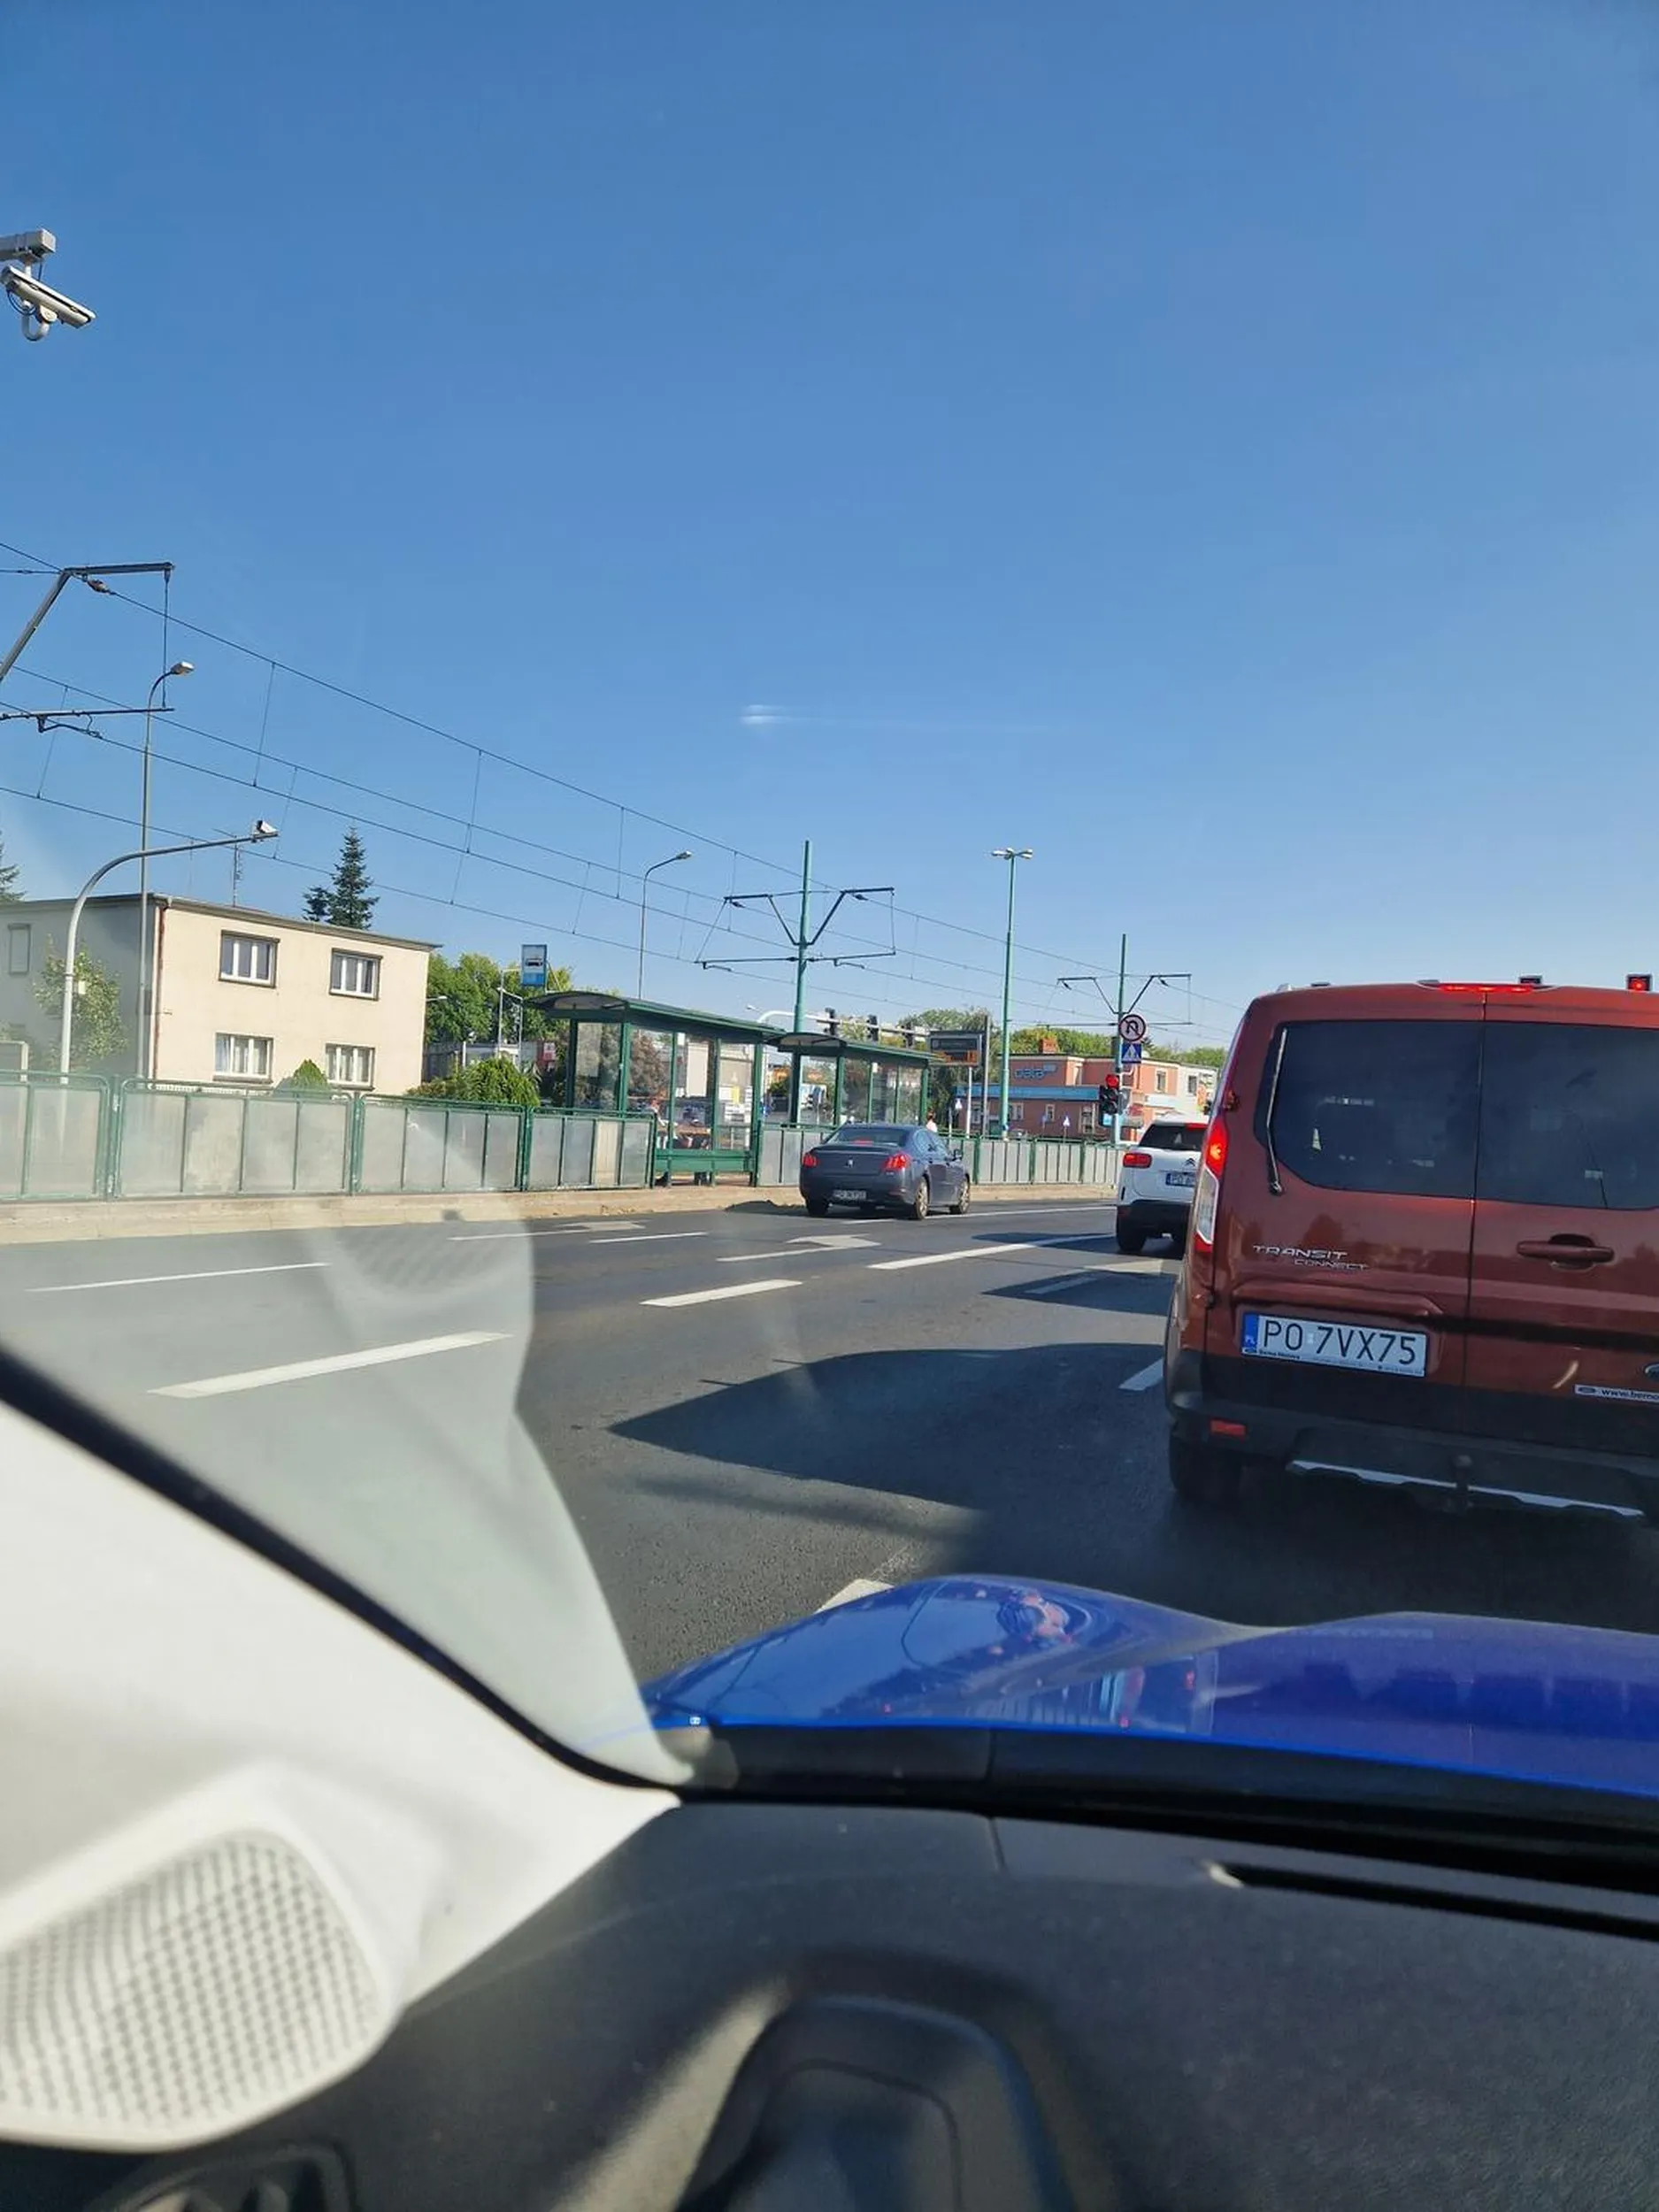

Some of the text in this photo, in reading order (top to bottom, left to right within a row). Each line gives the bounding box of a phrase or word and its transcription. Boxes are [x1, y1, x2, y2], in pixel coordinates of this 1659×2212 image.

[1253, 1245, 1348, 1260] TRANSIT
[1294, 1258, 1370, 1271] CONNECT
[1263, 1319, 1417, 1365] PO 7VX75
